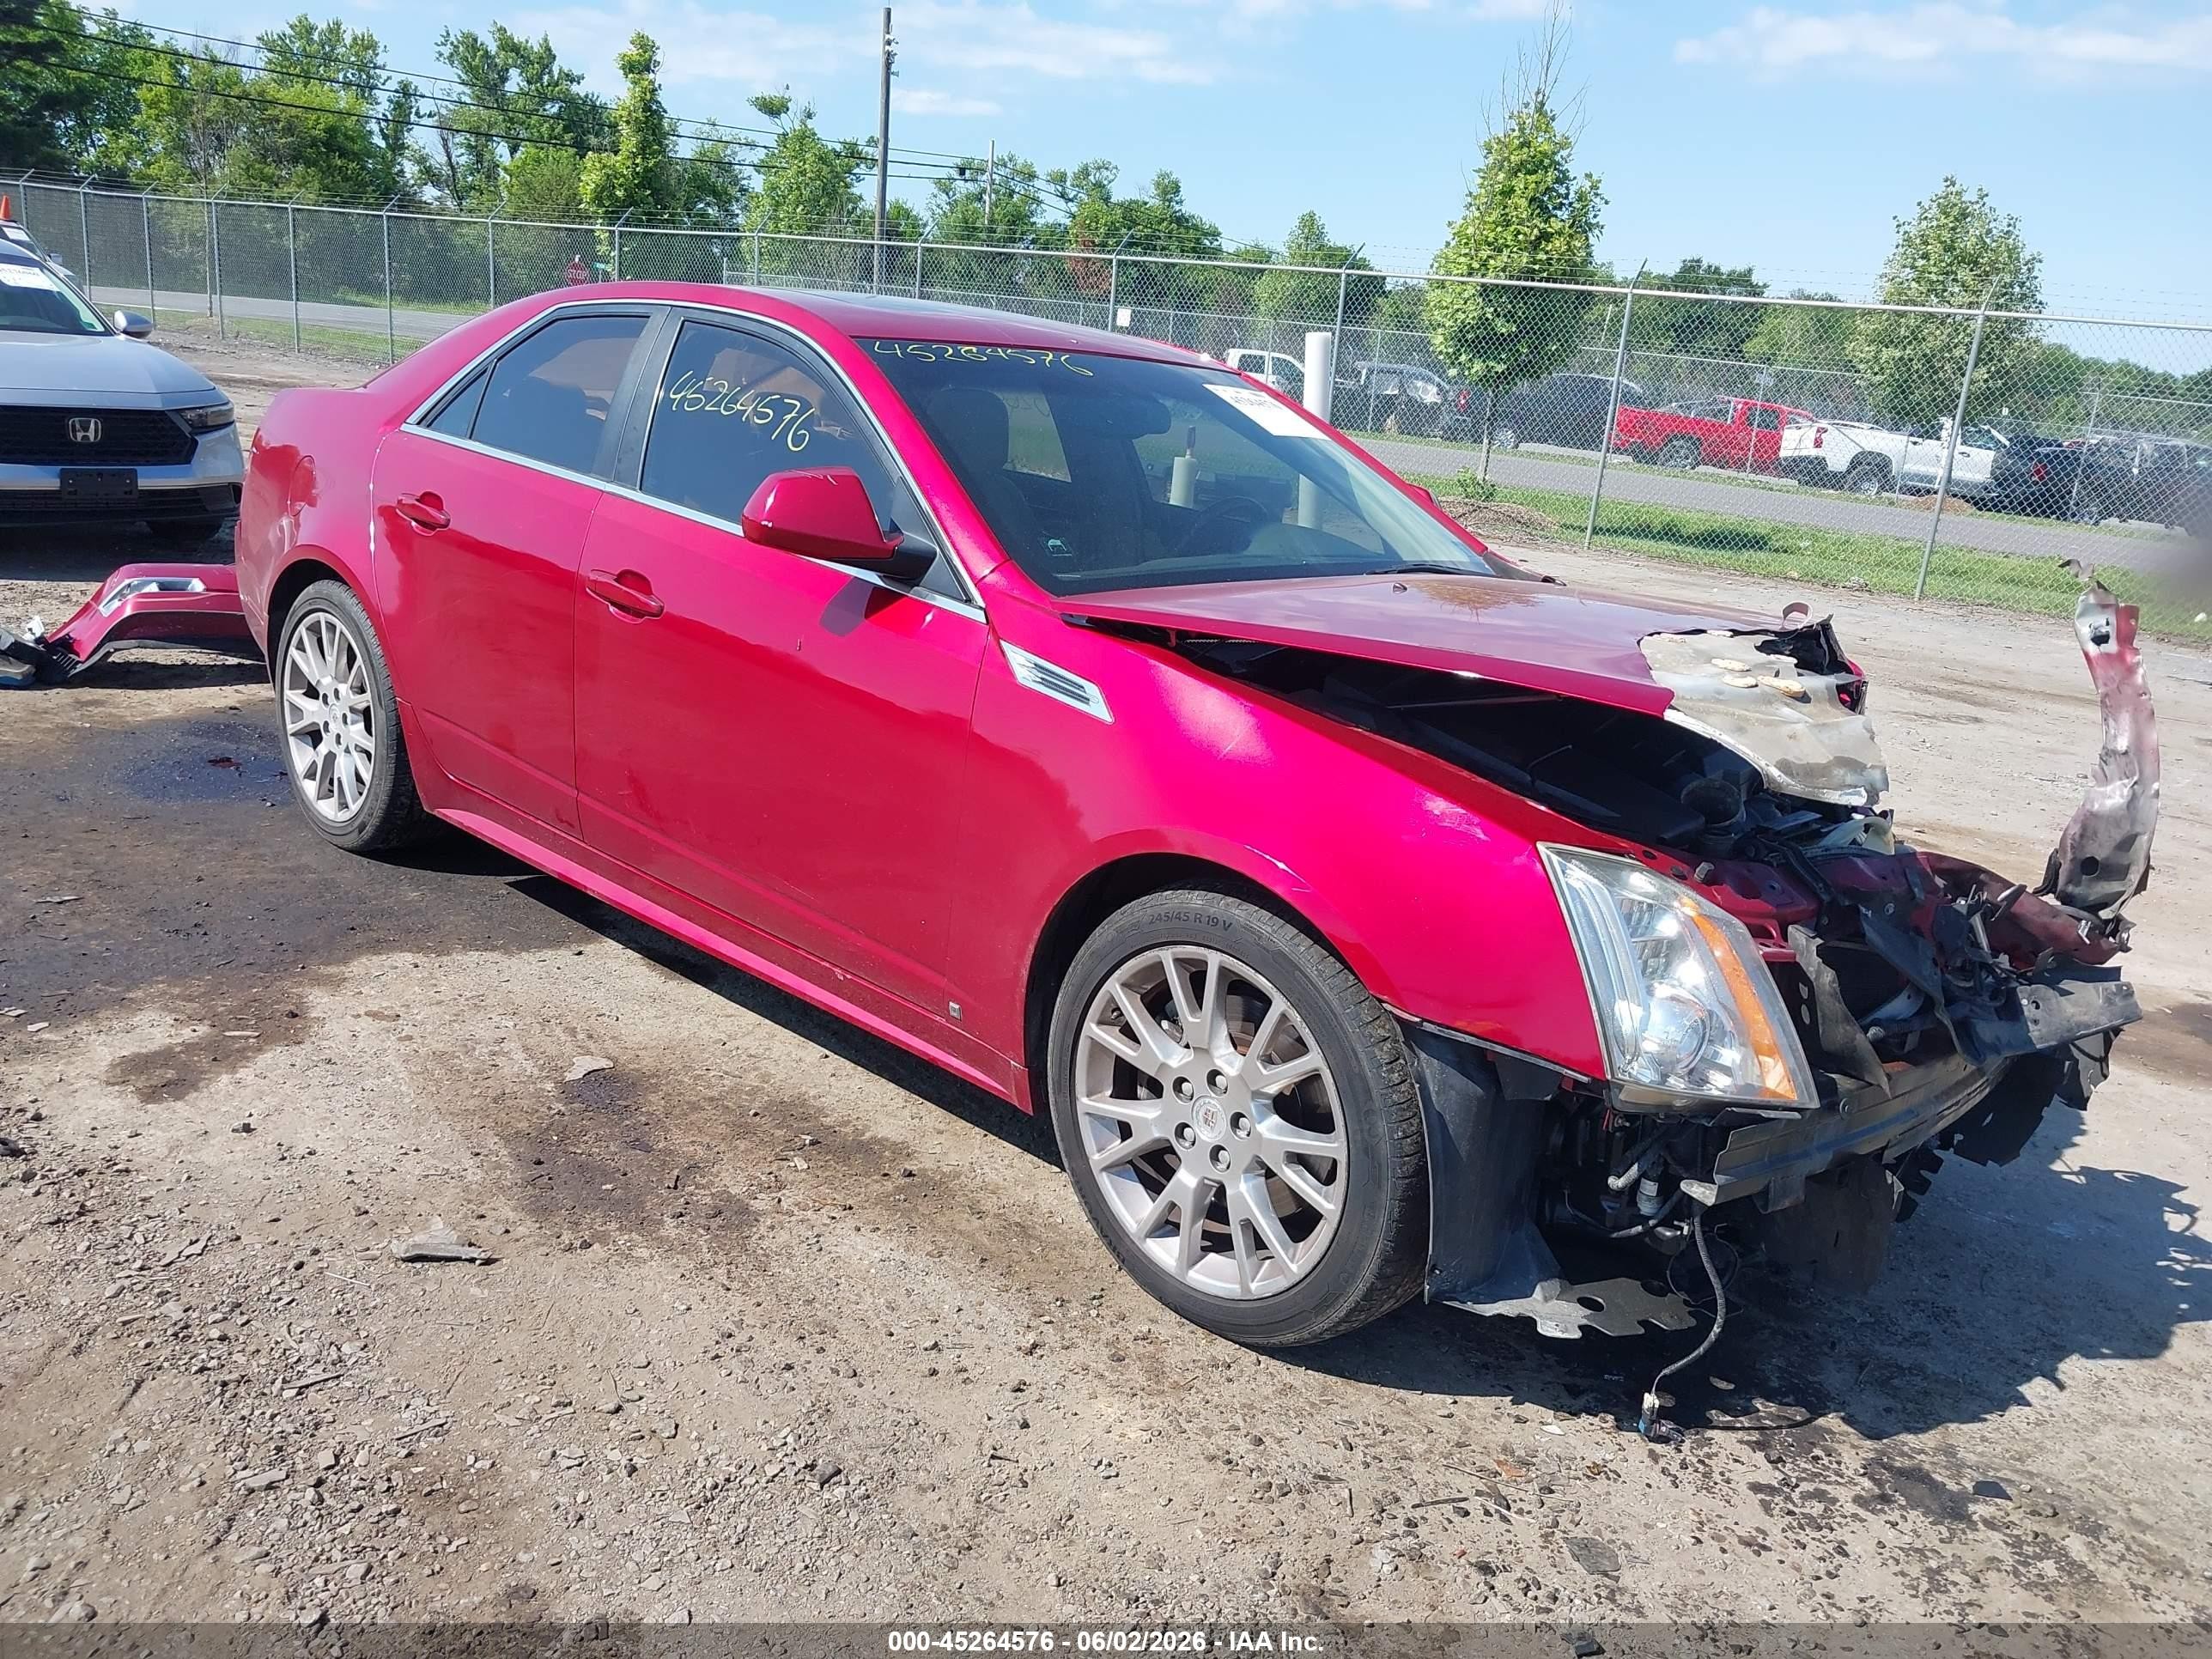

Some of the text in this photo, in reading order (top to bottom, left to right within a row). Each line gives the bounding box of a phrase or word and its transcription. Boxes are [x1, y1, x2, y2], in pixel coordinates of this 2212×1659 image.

[568, 269, 586, 279] STOP
[874, 341, 1094, 376] 45264576
[669, 370, 816, 452] 45264576
[1148, 910, 1233, 932] 245/45 R 19 V
